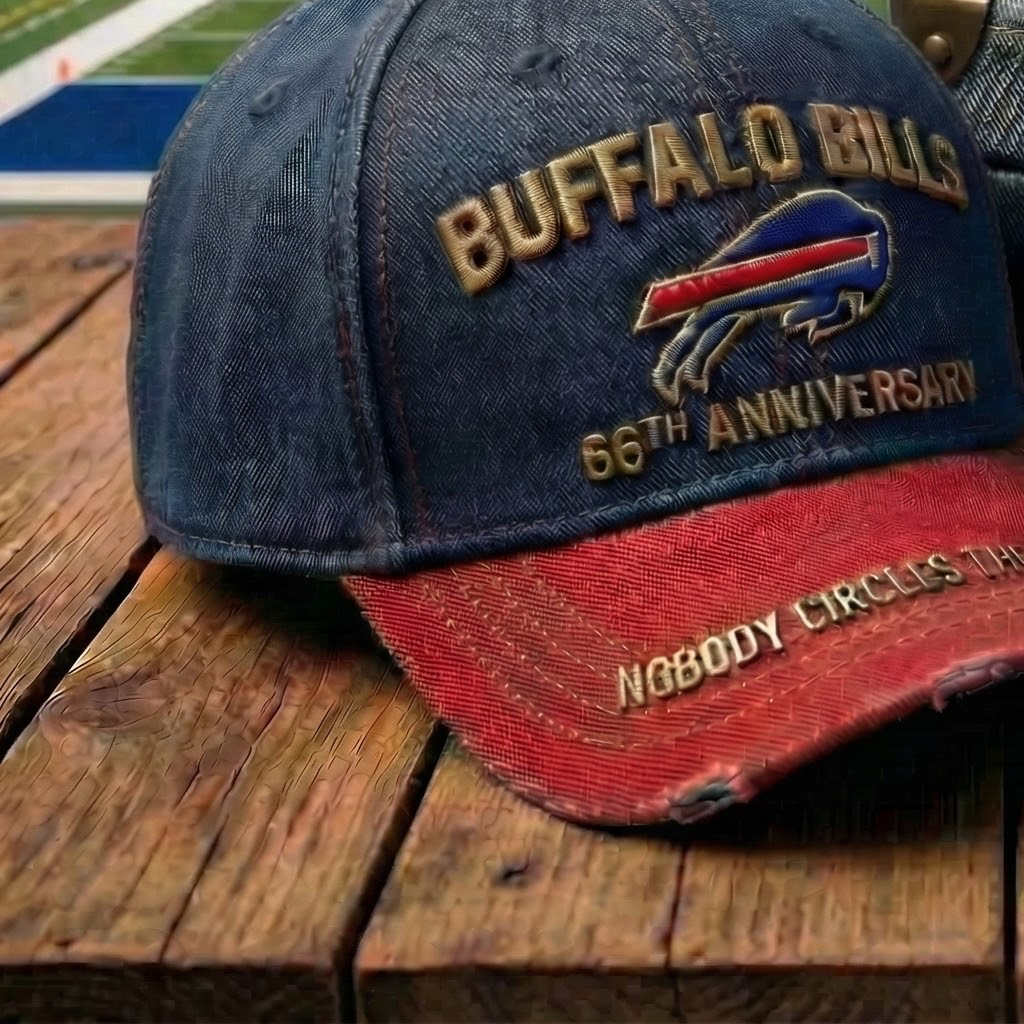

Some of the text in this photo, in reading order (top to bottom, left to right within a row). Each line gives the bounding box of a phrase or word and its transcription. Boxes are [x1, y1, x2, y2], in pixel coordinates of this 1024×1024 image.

[434, 102, 969, 297] BUFFALO BILLS
[579, 359, 977, 481] 66TH ANNIVERSARY
[618, 609, 786, 711] NOBODY
